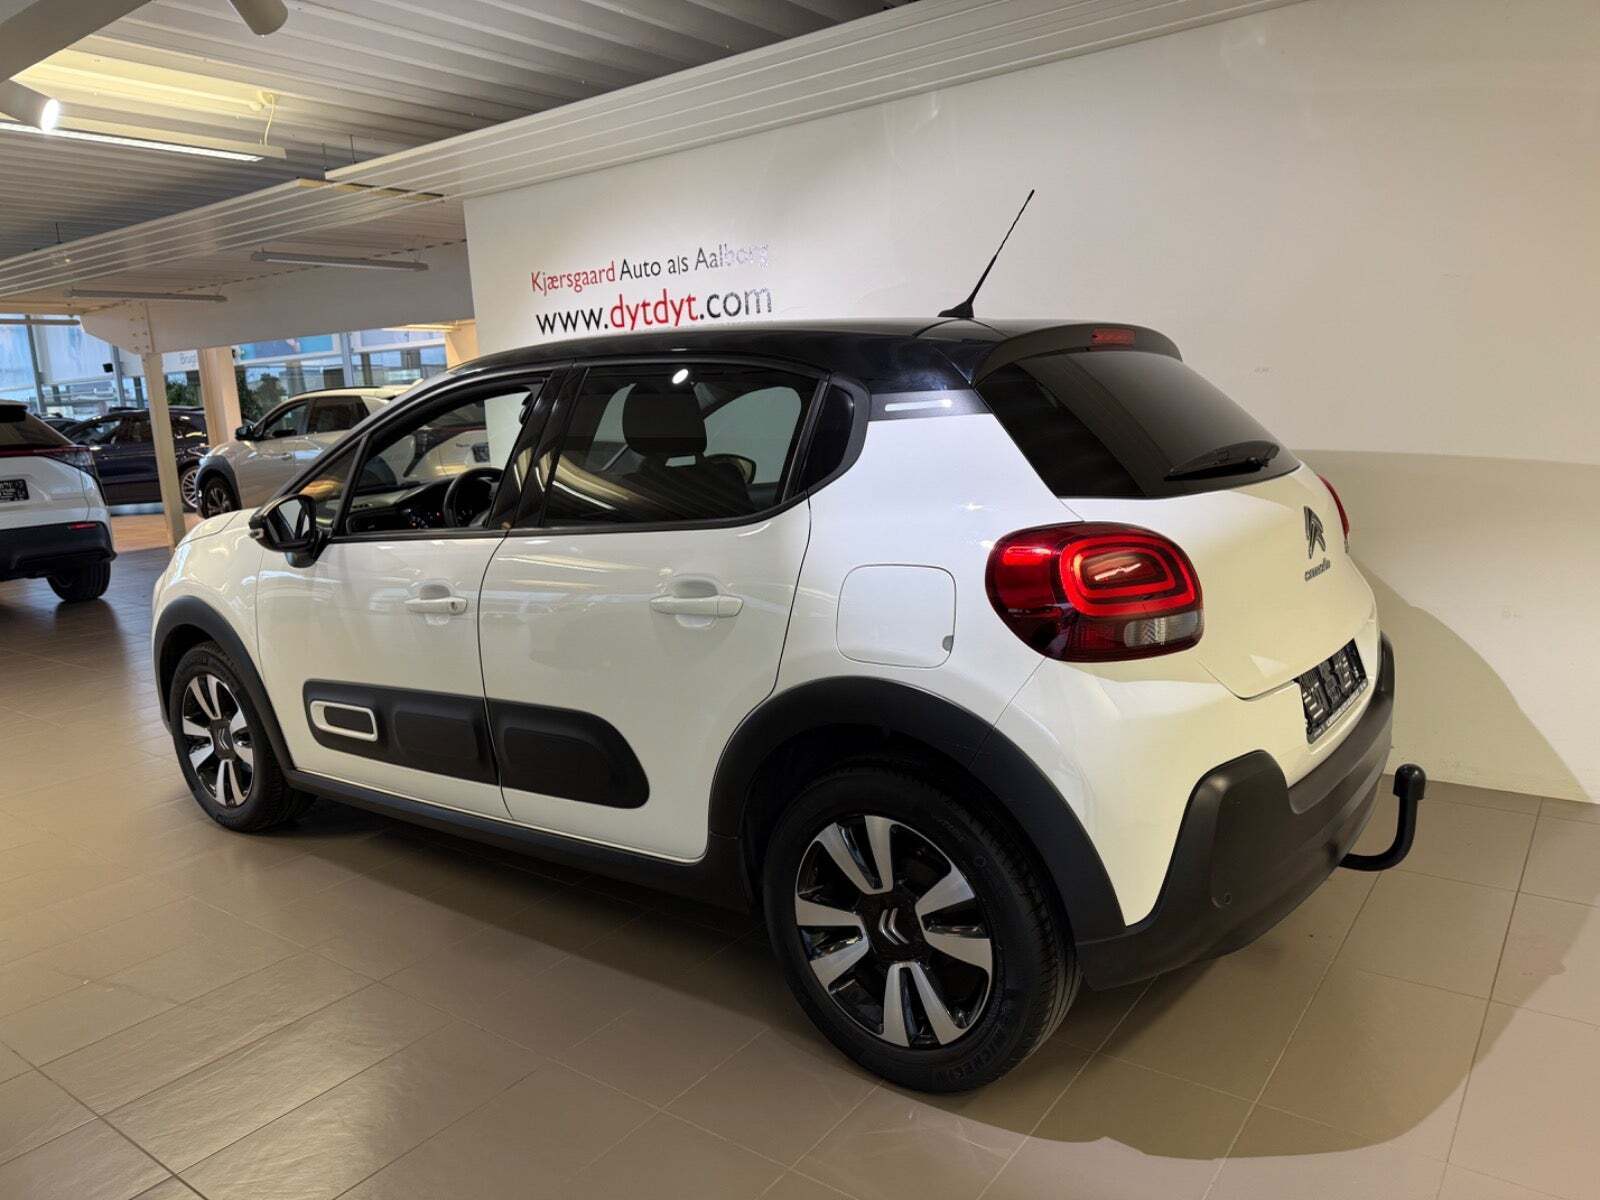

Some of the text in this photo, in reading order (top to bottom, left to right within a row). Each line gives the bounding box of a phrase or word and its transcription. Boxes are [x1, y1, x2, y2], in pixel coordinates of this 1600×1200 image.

[531, 260, 616, 296] Kjærsgaard
[619, 259, 661, 281] Auto
[694, 243, 769, 271] Aalbo
[535, 287, 772, 335] www.dytdyt.com
